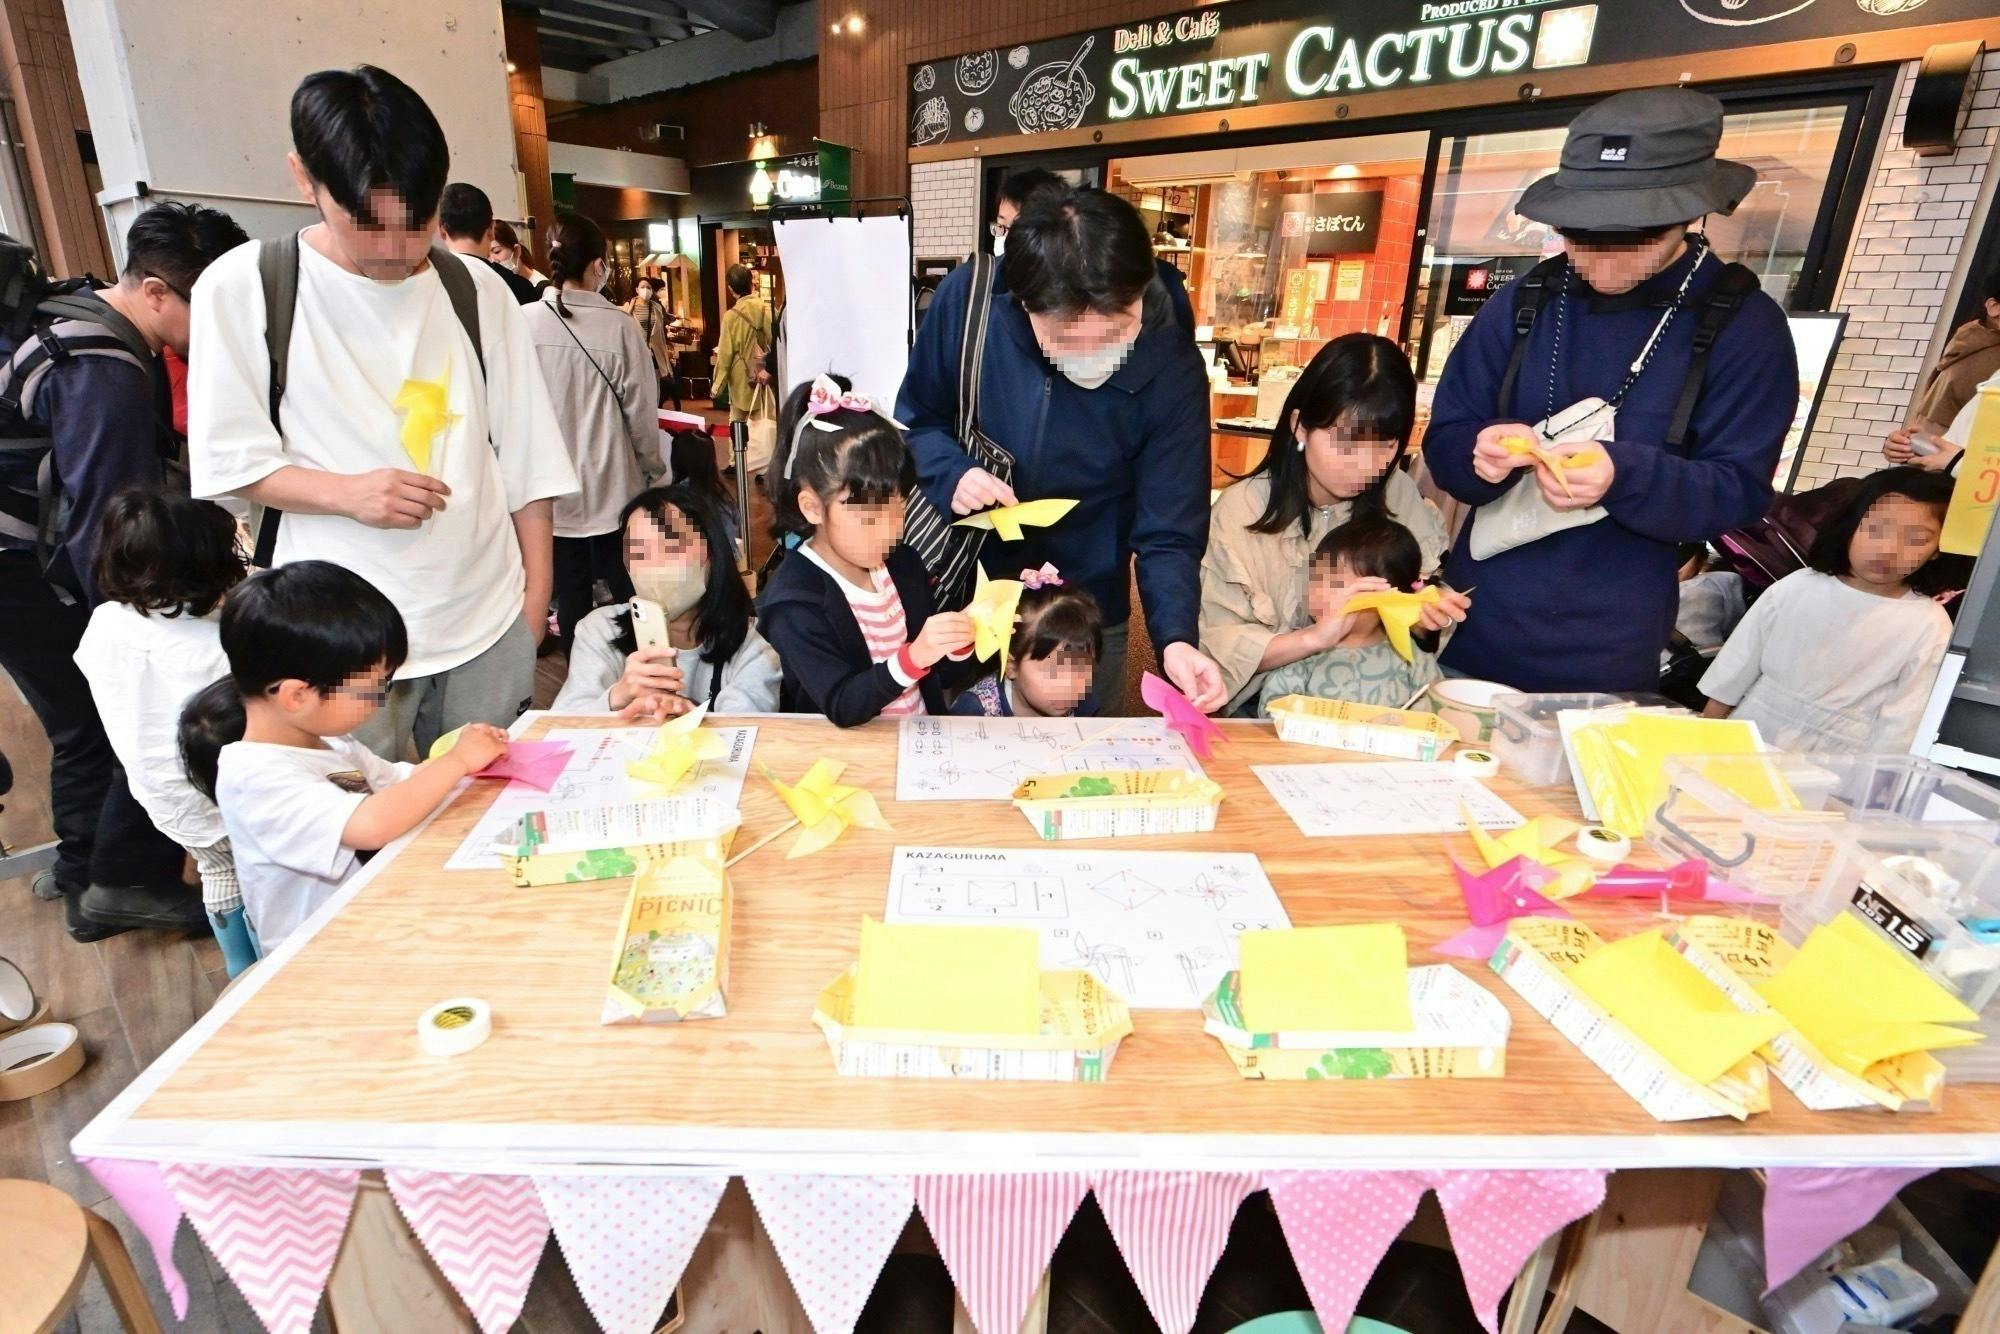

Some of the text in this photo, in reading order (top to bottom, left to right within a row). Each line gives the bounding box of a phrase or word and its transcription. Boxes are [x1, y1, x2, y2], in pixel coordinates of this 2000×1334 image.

[1420, 0, 1498, 21] PRODUCED
[1114, 11, 1220, 53] Deli & Café
[1108, 14, 1534, 118] SWEET CACTUS
[1314, 215, 1365, 231] さぽてん
[906, 852, 1007, 860] KAZAGURUMA
[637, 897, 723, 921] PICNIC
